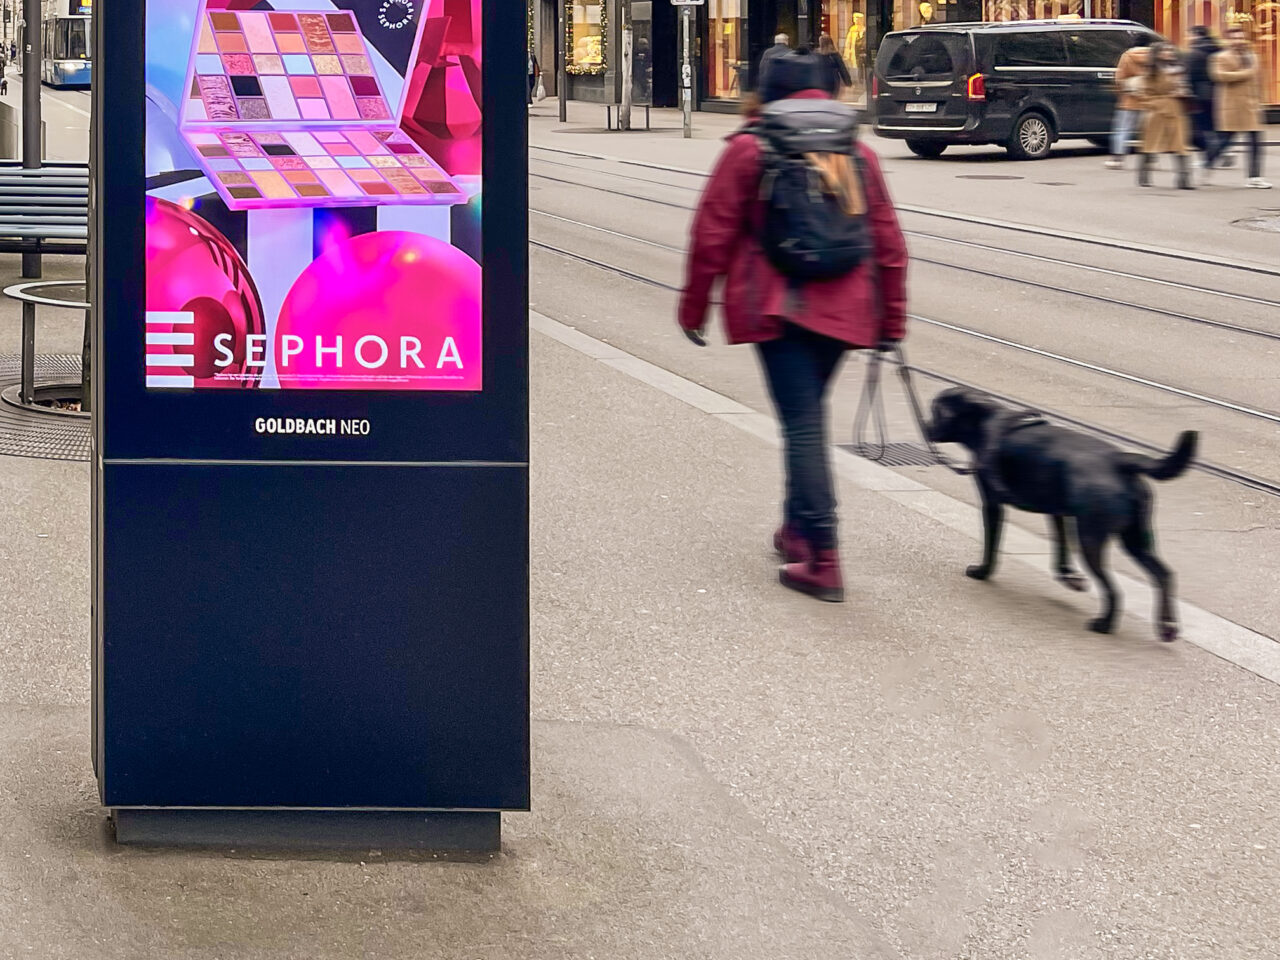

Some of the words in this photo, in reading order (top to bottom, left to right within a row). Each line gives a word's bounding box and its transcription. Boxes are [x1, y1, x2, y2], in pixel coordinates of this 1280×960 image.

[378, 13, 413, 30] SEPHORA
[213, 333, 464, 369] SEPHORA
[255, 418, 336, 435] GOLDBACH
[341, 419, 370, 435] NEO
